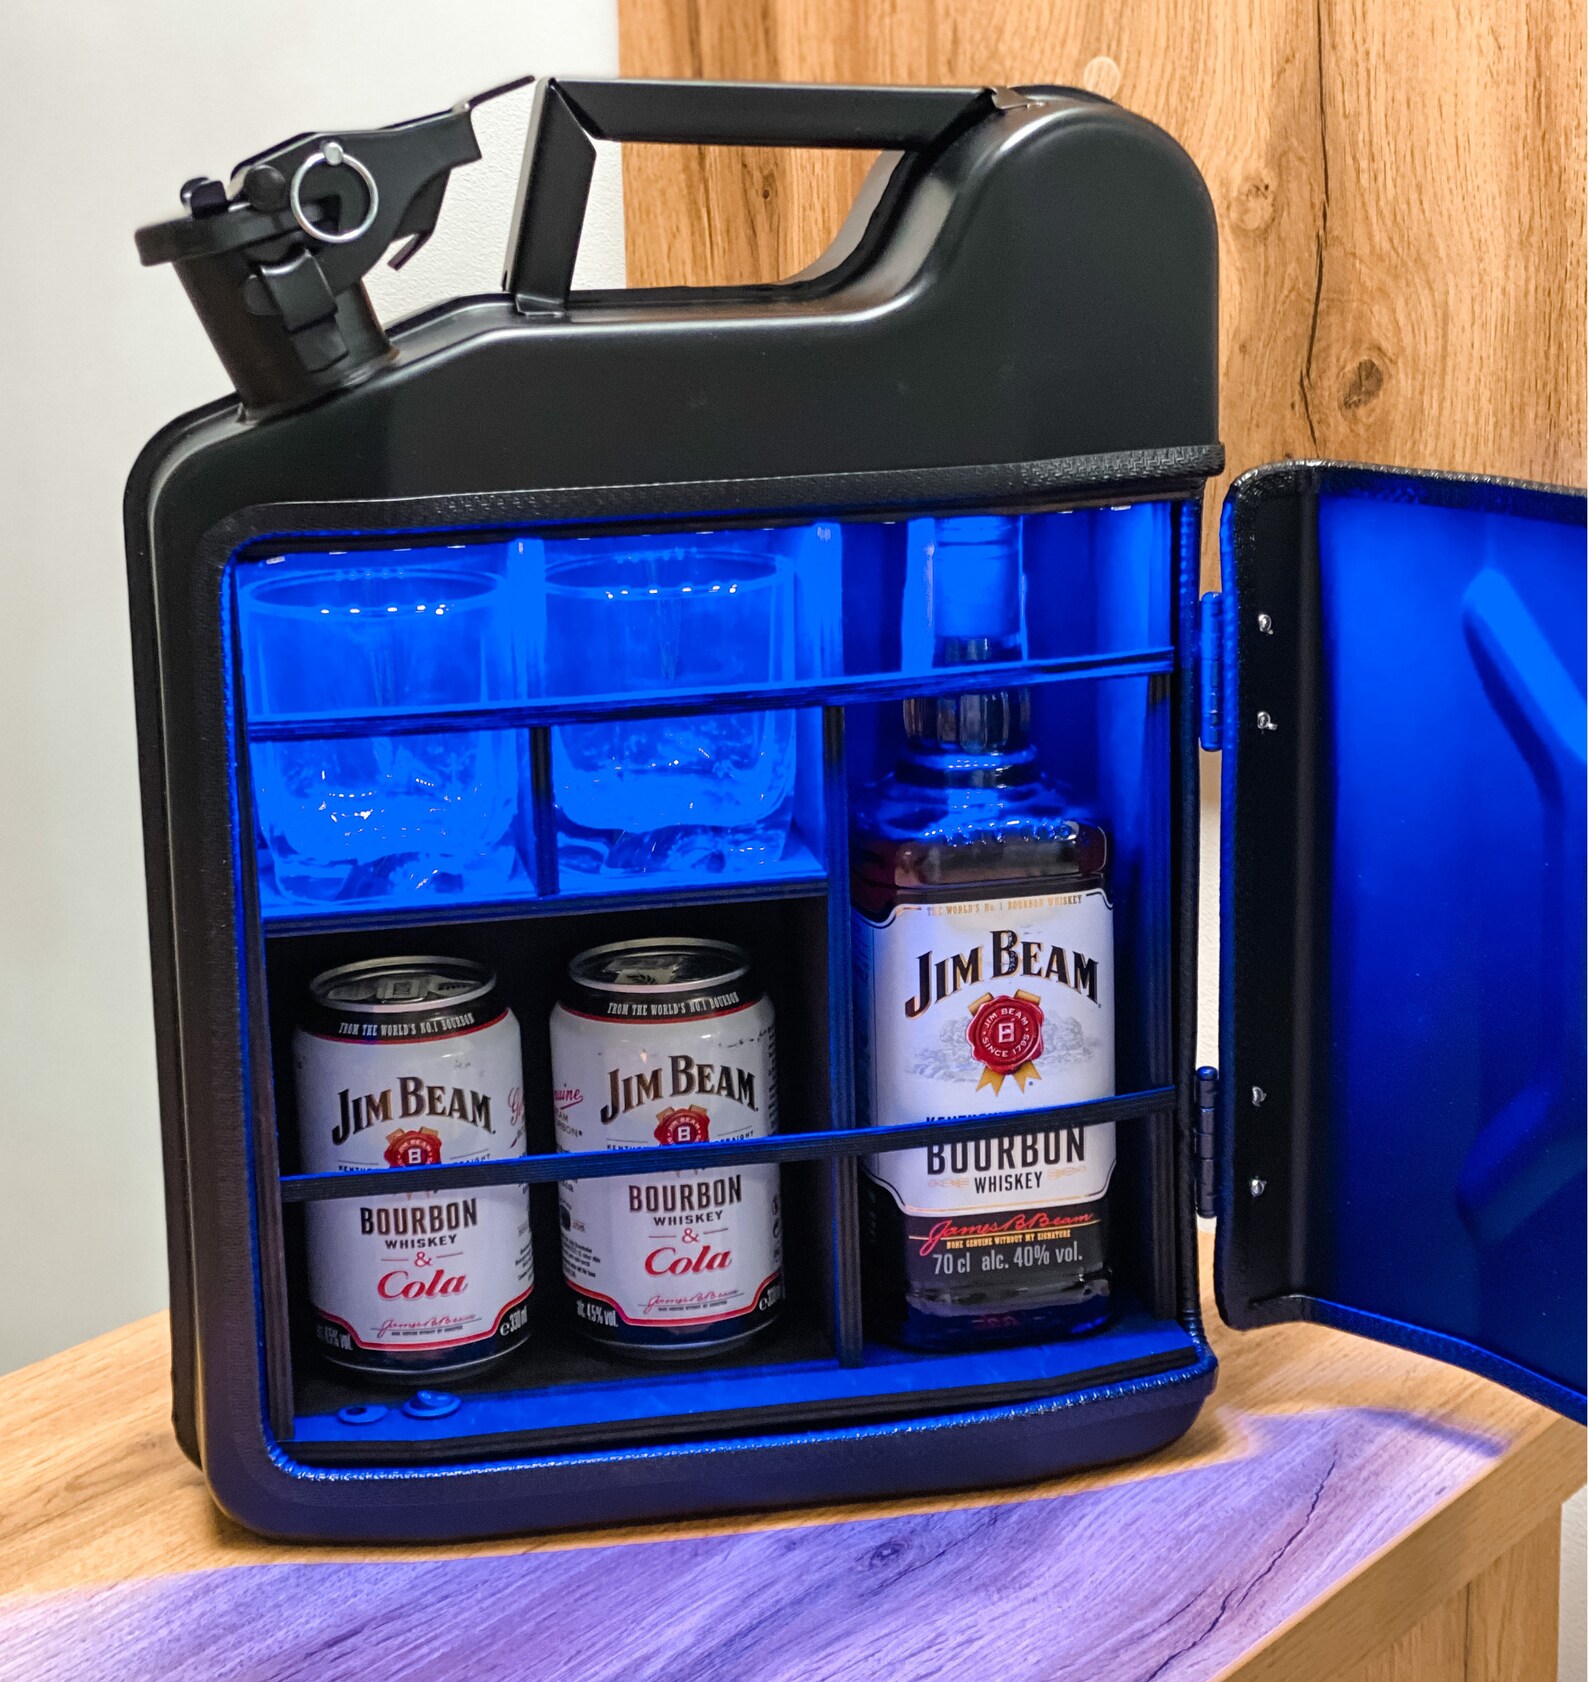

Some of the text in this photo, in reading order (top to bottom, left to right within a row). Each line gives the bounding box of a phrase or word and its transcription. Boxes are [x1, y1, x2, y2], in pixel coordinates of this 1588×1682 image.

[946, 904, 980, 915] WORLD'S
[1007, 899, 1044, 910] BOURBON
[1047, 895, 1082, 906] WHISKEY
[905, 929, 1099, 1020] JIM BEAM
[607, 1002, 629, 1015] FROM
[632, 1004, 648, 1016] THE
[651, 1002, 686, 1016] WORLD'S
[709, 991, 740, 1009] BOURBON
[339, 1022, 360, 1035] FROM
[362, 1024, 378, 1036] THE
[381, 1023, 417, 1036] WORLD'S
[441, 1012, 475, 1031] BOURBON
[984, 1008, 1029, 1028] JIM BEAM
[982, 1034, 1030, 1058] SINCE 1795
[600, 1068, 664, 1125] JIM
[669, 1054, 758, 1112] BEAM
[332, 1088, 394, 1146] JIM
[397, 1076, 496, 1135] BEAM
[927, 1127, 1085, 1175] BOURBON
[628, 1174, 742, 1213] BOURBON
[974, 1171, 1043, 1194] WHISKEY
[360, 1198, 478, 1236] BOURBON
[653, 1210, 724, 1226] WHISKEY
[385, 1234, 458, 1249] WHISKEY
[681, 1228, 700, 1243] &
[920, 1219, 1003, 1257] James
[966, 1238, 993, 1248] GENUINE
[994, 1235, 1023, 1245] WITHOUT
[1025, 1233, 1035, 1242] MY
[1037, 1230, 1071, 1241] SIGNATURE
[414, 1251, 433, 1267] &
[644, 1245, 733, 1276] Cola
[933, 1241, 1083, 1275] 70 cl alc. 40% vol.
[377, 1269, 468, 1300] Cola
